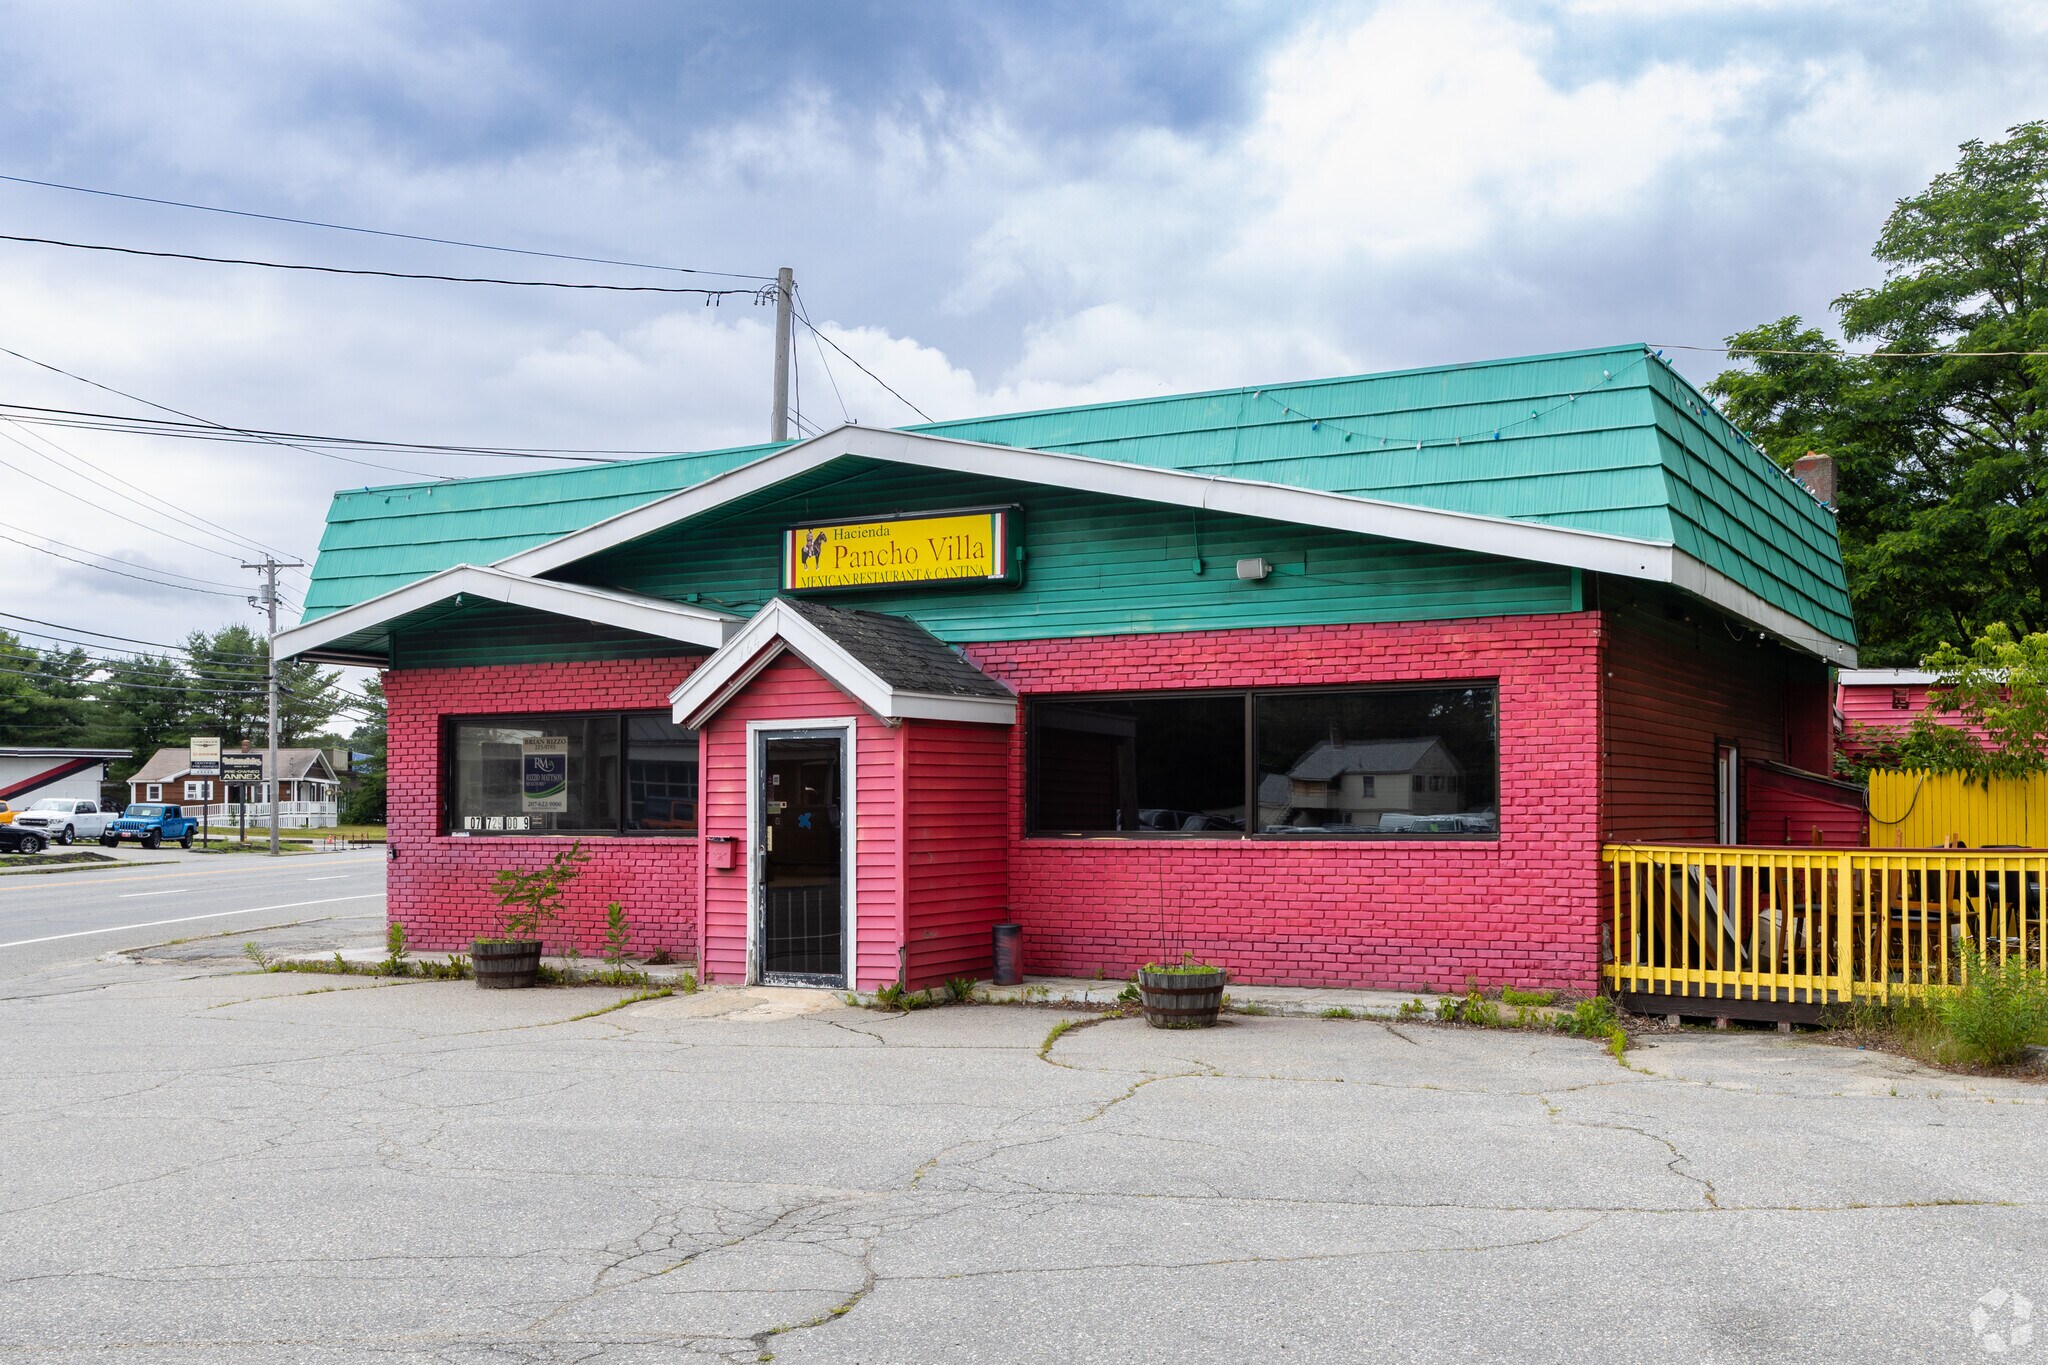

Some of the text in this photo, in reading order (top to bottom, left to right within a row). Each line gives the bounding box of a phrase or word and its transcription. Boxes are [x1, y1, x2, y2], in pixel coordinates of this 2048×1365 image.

[834, 524, 890, 540] Hacienda
[833, 534, 985, 569] Pancho Villa
[801, 564, 985, 588] MEXICAN RESTAURANT & CANTINA
